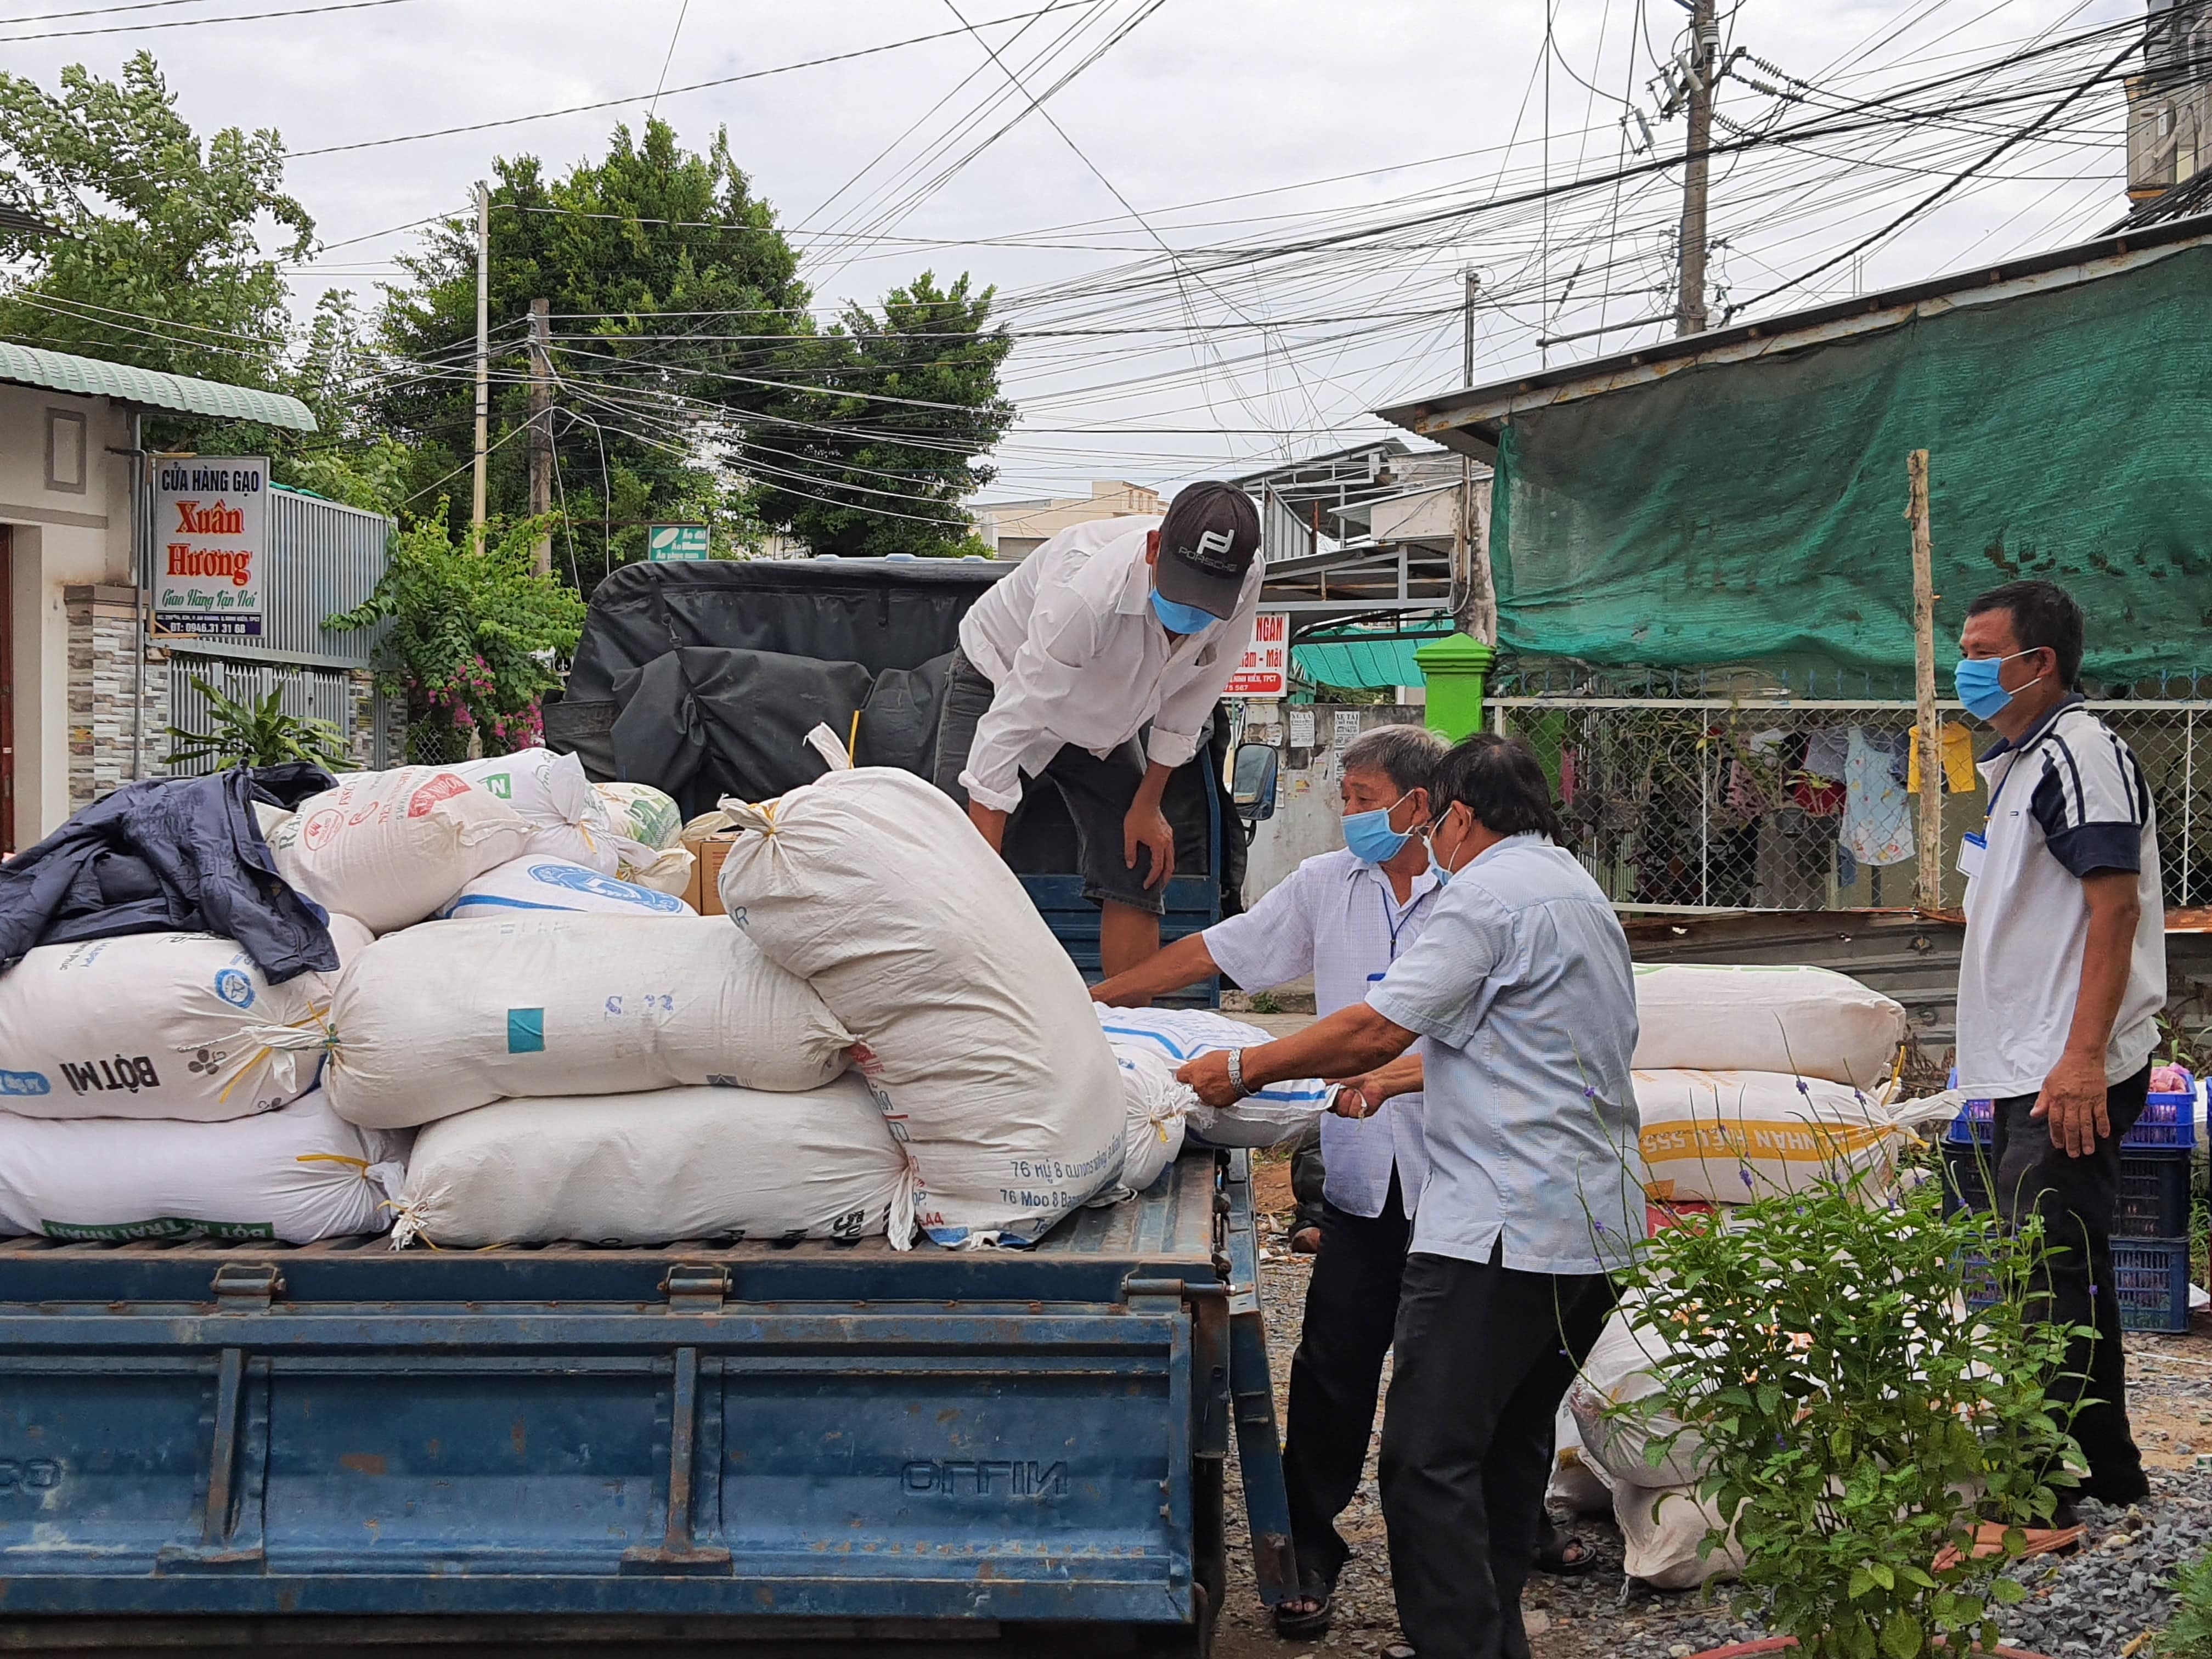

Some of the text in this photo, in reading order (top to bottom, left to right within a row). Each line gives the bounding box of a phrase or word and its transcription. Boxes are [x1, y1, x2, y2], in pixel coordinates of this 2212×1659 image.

[162, 462, 259, 497] CỬA HÀNG GẠO
[176, 499, 245, 535] Xuân
[167, 543, 252, 586] Hương
[1178, 546, 1238, 572] PORSCHE
[162, 589, 184, 607] Giao
[188, 589, 214, 611] Hàng
[222, 623, 232, 633] 31
[59, 1061, 104, 1096] MÌ
[99, 1054, 160, 1093] BỘT
[1011, 1161, 1030, 1177] 76
[1054, 1161, 1063, 1178] 8
[1000, 1189, 1017, 1204] 76
[1021, 1191, 1049, 1207] Moo
[1052, 1191, 1058, 1207] 8
